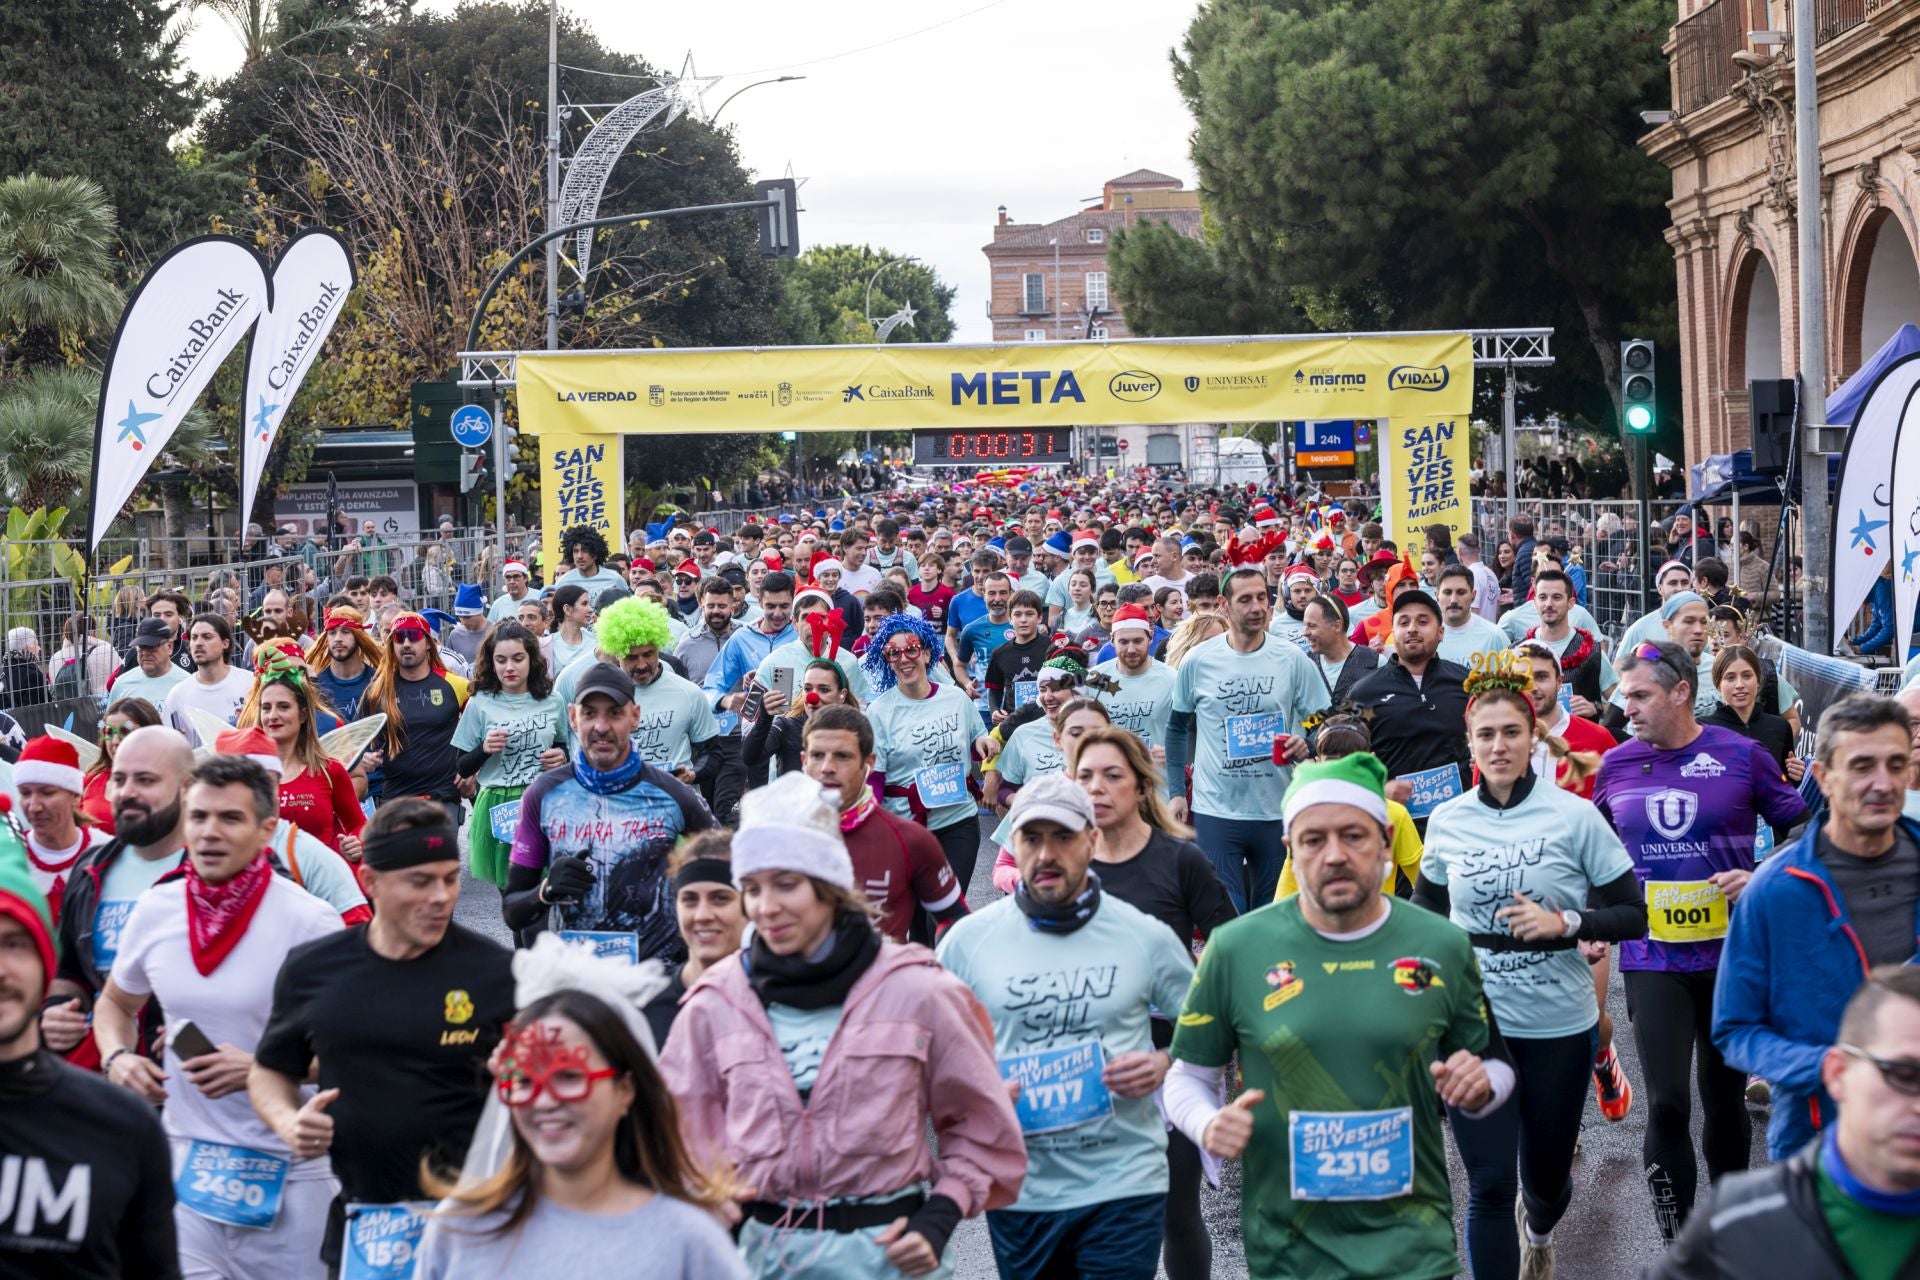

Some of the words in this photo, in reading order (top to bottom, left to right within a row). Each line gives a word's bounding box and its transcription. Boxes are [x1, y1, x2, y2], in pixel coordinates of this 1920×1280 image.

[146, 287, 245, 400] CaixaBank
[268, 281, 342, 391] CaixaBank
[951, 370, 1086, 406] META
[1114, 379, 1156, 394] Juver
[1206, 375, 1268, 385] UNIVERSAE
[1310, 374, 1366, 386] marmo
[1397, 372, 1442, 385] VIDAL
[557, 392, 577, 402] LA
[578, 391, 637, 402] VERDAD
[869, 385, 935, 399] CaixaBank
[951, 433, 1053, 457] 0:00:31
[1320, 434, 1341, 445] 24h
[1402, 421, 1455, 448] SAN
[553, 444, 605, 471] SAN
[1410, 443, 1447, 467] SIL
[561, 464, 598, 488] SIL
[1407, 459, 1453, 486] VES
[351, 490, 400, 499] AVANZADA
[556, 481, 604, 508] VES
[1408, 480, 1455, 506] TRE
[297, 503, 303, 511] Y
[346, 502, 382, 510] DENTAL
[558, 501, 606, 526] TRE
[1408, 498, 1459, 519] MURCIA
[1464, 647, 1534, 692] 2025
[1216, 675, 1274, 700] SAN
[1226, 696, 1264, 716] SIL
[911, 714, 958, 745] SAN
[1232, 718, 1252, 729] SAN
[1232, 715, 1281, 736] SILVESTRE
[920, 768, 938, 780] SAN
[921, 765, 961, 788] SILVESTRE
[929, 780, 958, 797] 2918
[1411, 785, 1454, 806] 2948
[494, 806, 508, 818] SAN
[500, 822, 517, 834] 27
[550, 818, 567, 842] LA
[575, 819, 613, 843] VARA
[621, 818, 667, 841] TRAIL
[1461, 838, 1545, 877] SAN
[1641, 841, 1709, 855] UNIVERSAE
[1642, 853, 1666, 861] Instituto
[1666, 852, 1692, 860] Superior
[1655, 887, 1680, 899] SAN
[1655, 884, 1720, 910] SILVESTRE
[102, 903, 129, 918] SAN
[1664, 907, 1711, 925] 1001
[1005, 965, 1117, 1010] SAN
[1022, 1002, 1098, 1044] SIL
[1009, 1056, 1040, 1076] SAN
[1060, 1061, 1095, 1082] MURCIA
[1025, 1079, 1084, 1112] 1717
[1302, 1114, 1402, 1154] SILVESTRE
[1303, 1119, 1345, 1138] SAN
[196, 1143, 231, 1158] SAN
[1362, 1131, 1401, 1150] MURCIA
[190, 1157, 282, 1173] SILVESTRE
[1316, 1148, 1391, 1176] 2316
[189, 1170, 265, 1208] 2490
[359, 1211, 391, 1225] SAN
[366, 1241, 414, 1267] 159
